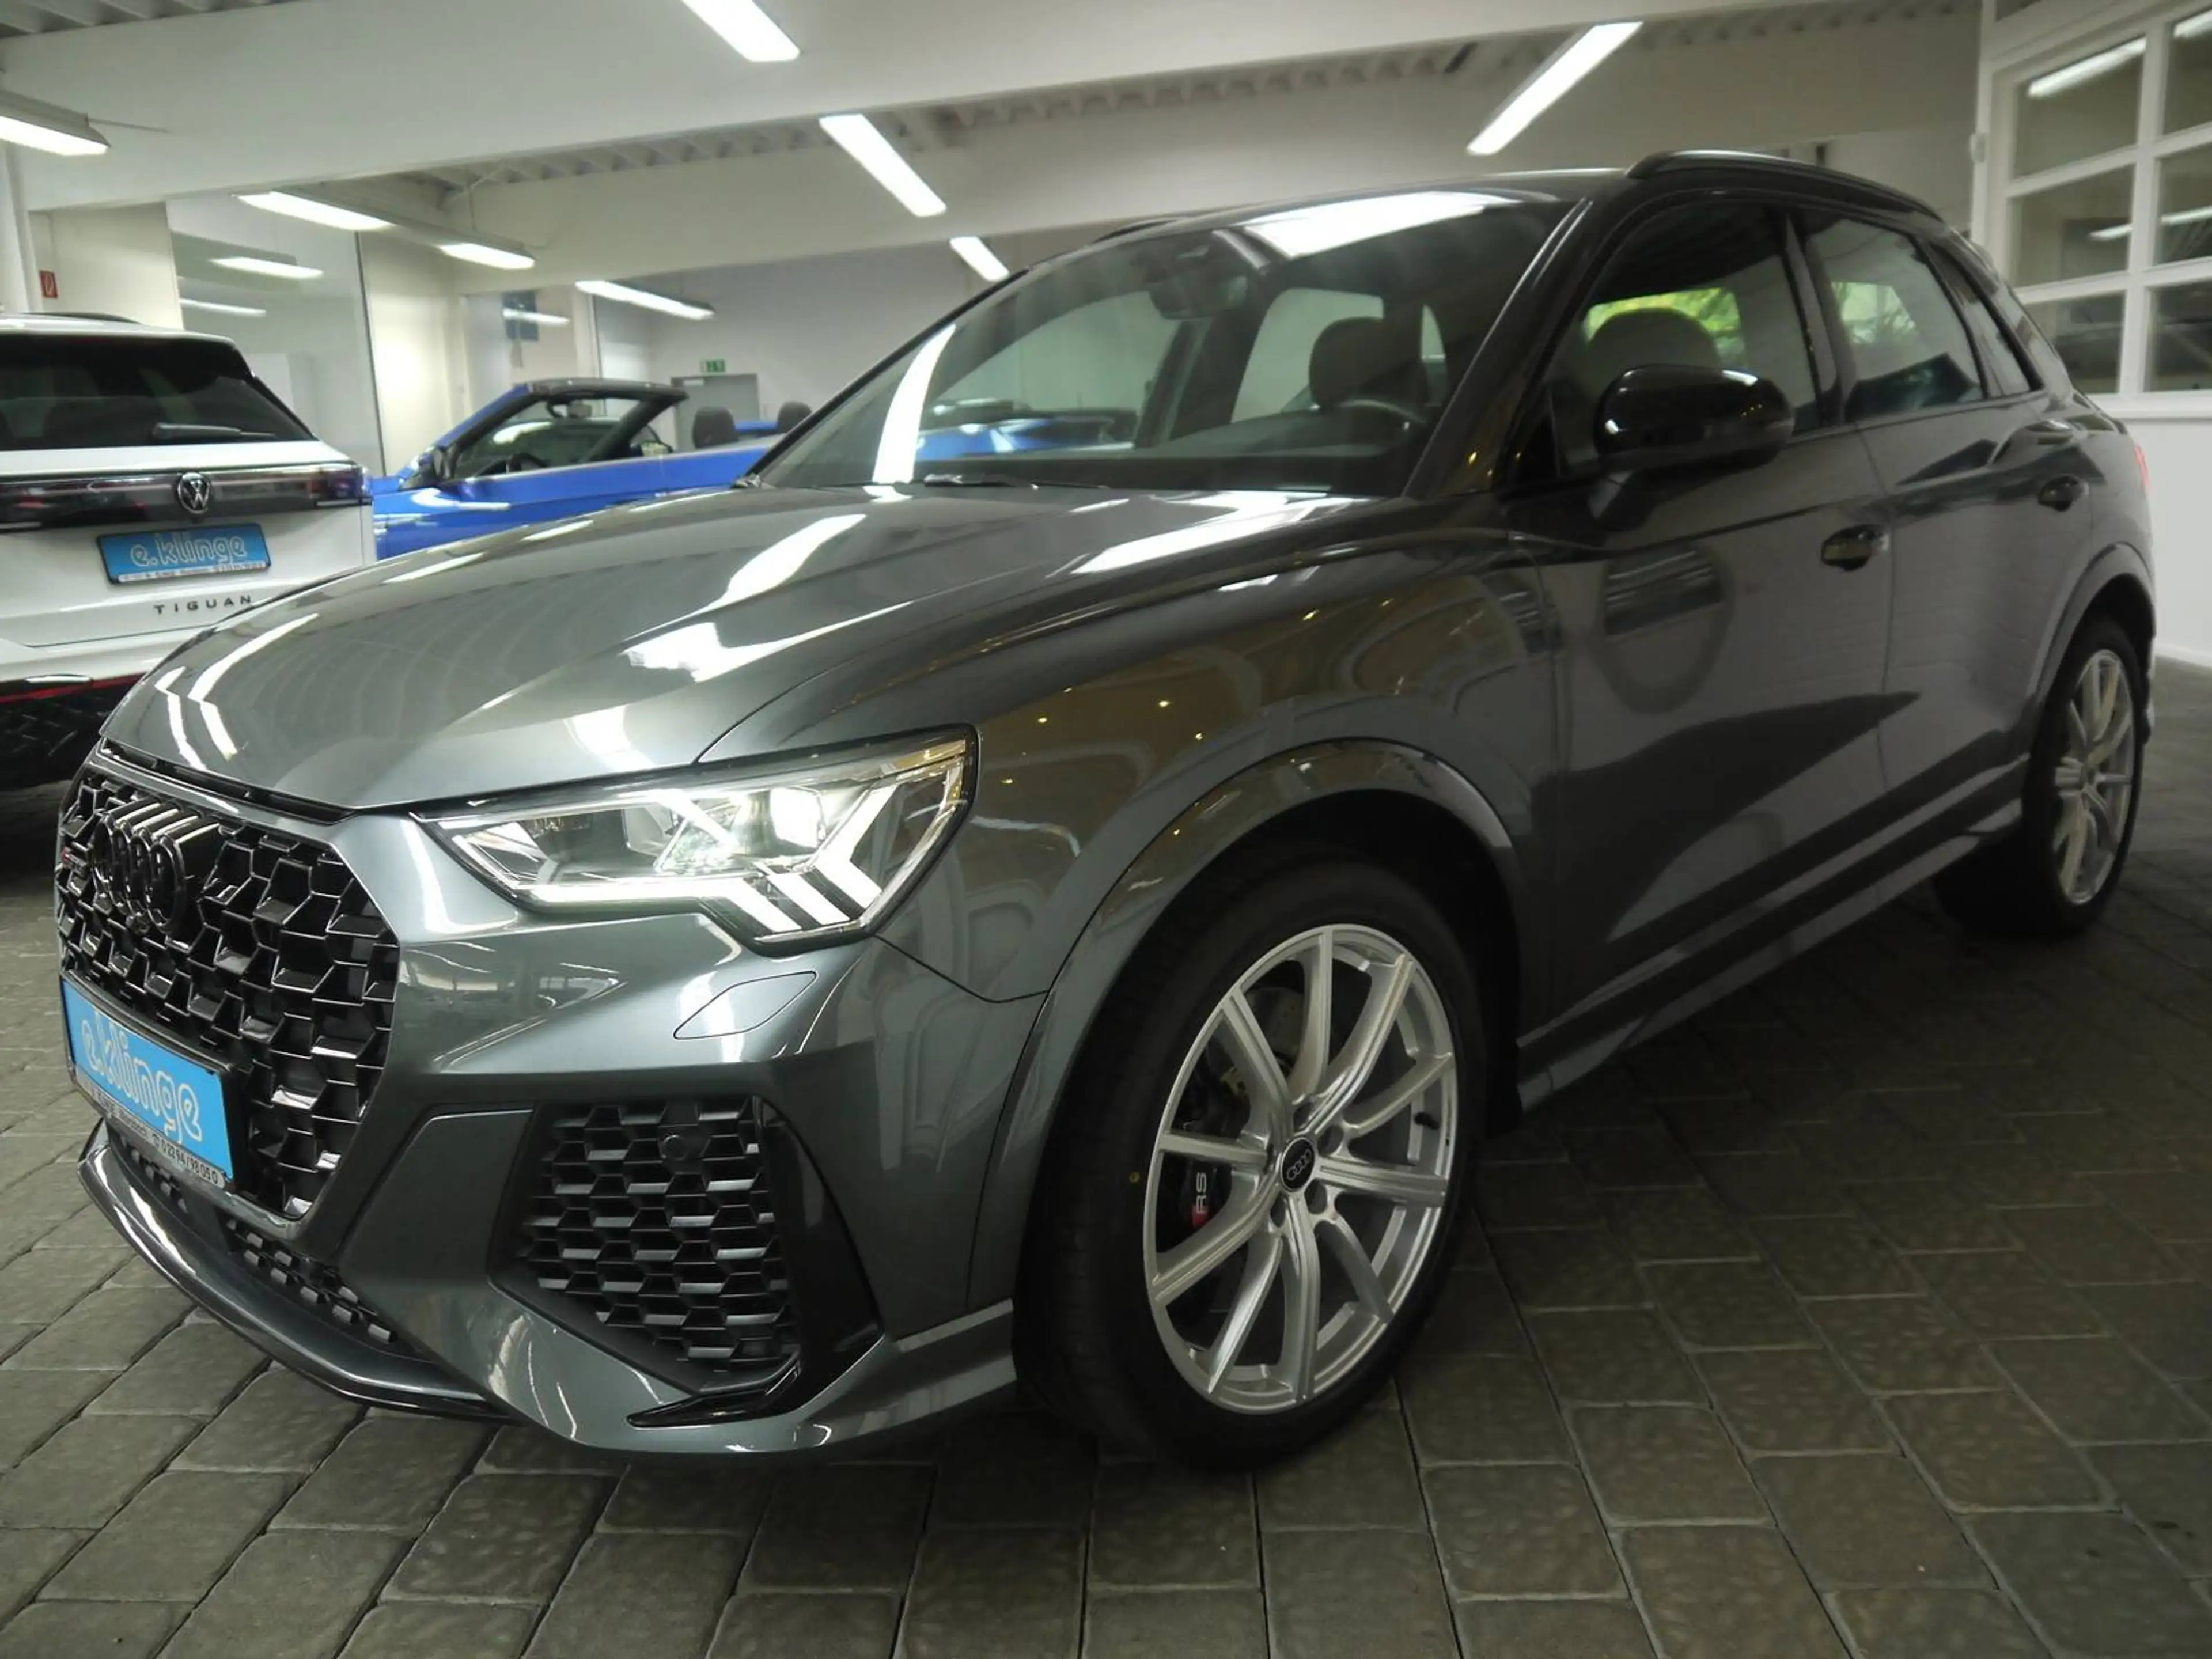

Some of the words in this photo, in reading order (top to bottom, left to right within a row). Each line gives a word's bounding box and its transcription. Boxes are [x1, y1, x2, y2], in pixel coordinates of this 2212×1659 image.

[131, 532, 248, 567] e.klinge
[153, 594, 252, 615] TIGUAN
[82, 1009, 202, 1144] e.klinge
[1196, 1172, 1207, 1215] RS
